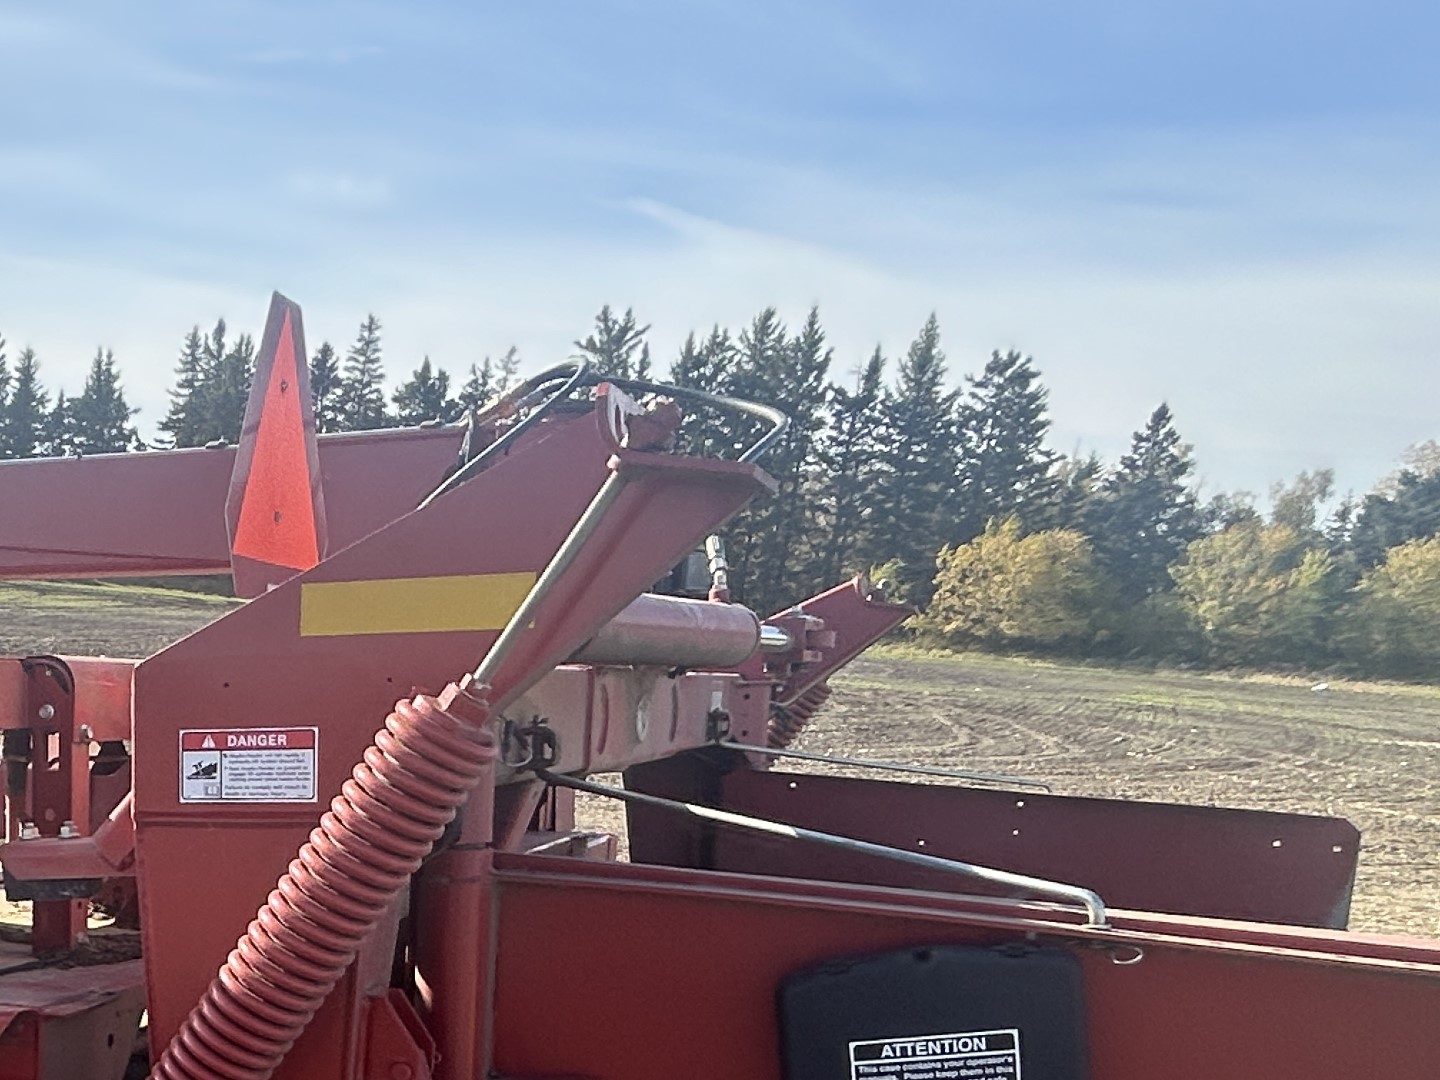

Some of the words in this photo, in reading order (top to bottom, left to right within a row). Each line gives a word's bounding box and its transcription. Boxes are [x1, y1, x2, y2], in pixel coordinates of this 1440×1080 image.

[227, 734, 288, 747] DANGER
[881, 1037, 986, 1058] ATTENTION
[902, 1061, 942, 1071] contains
[943, 1061, 964, 1069] your
[966, 1056, 1013, 1066] operator's
[903, 1072, 934, 1080] Please
